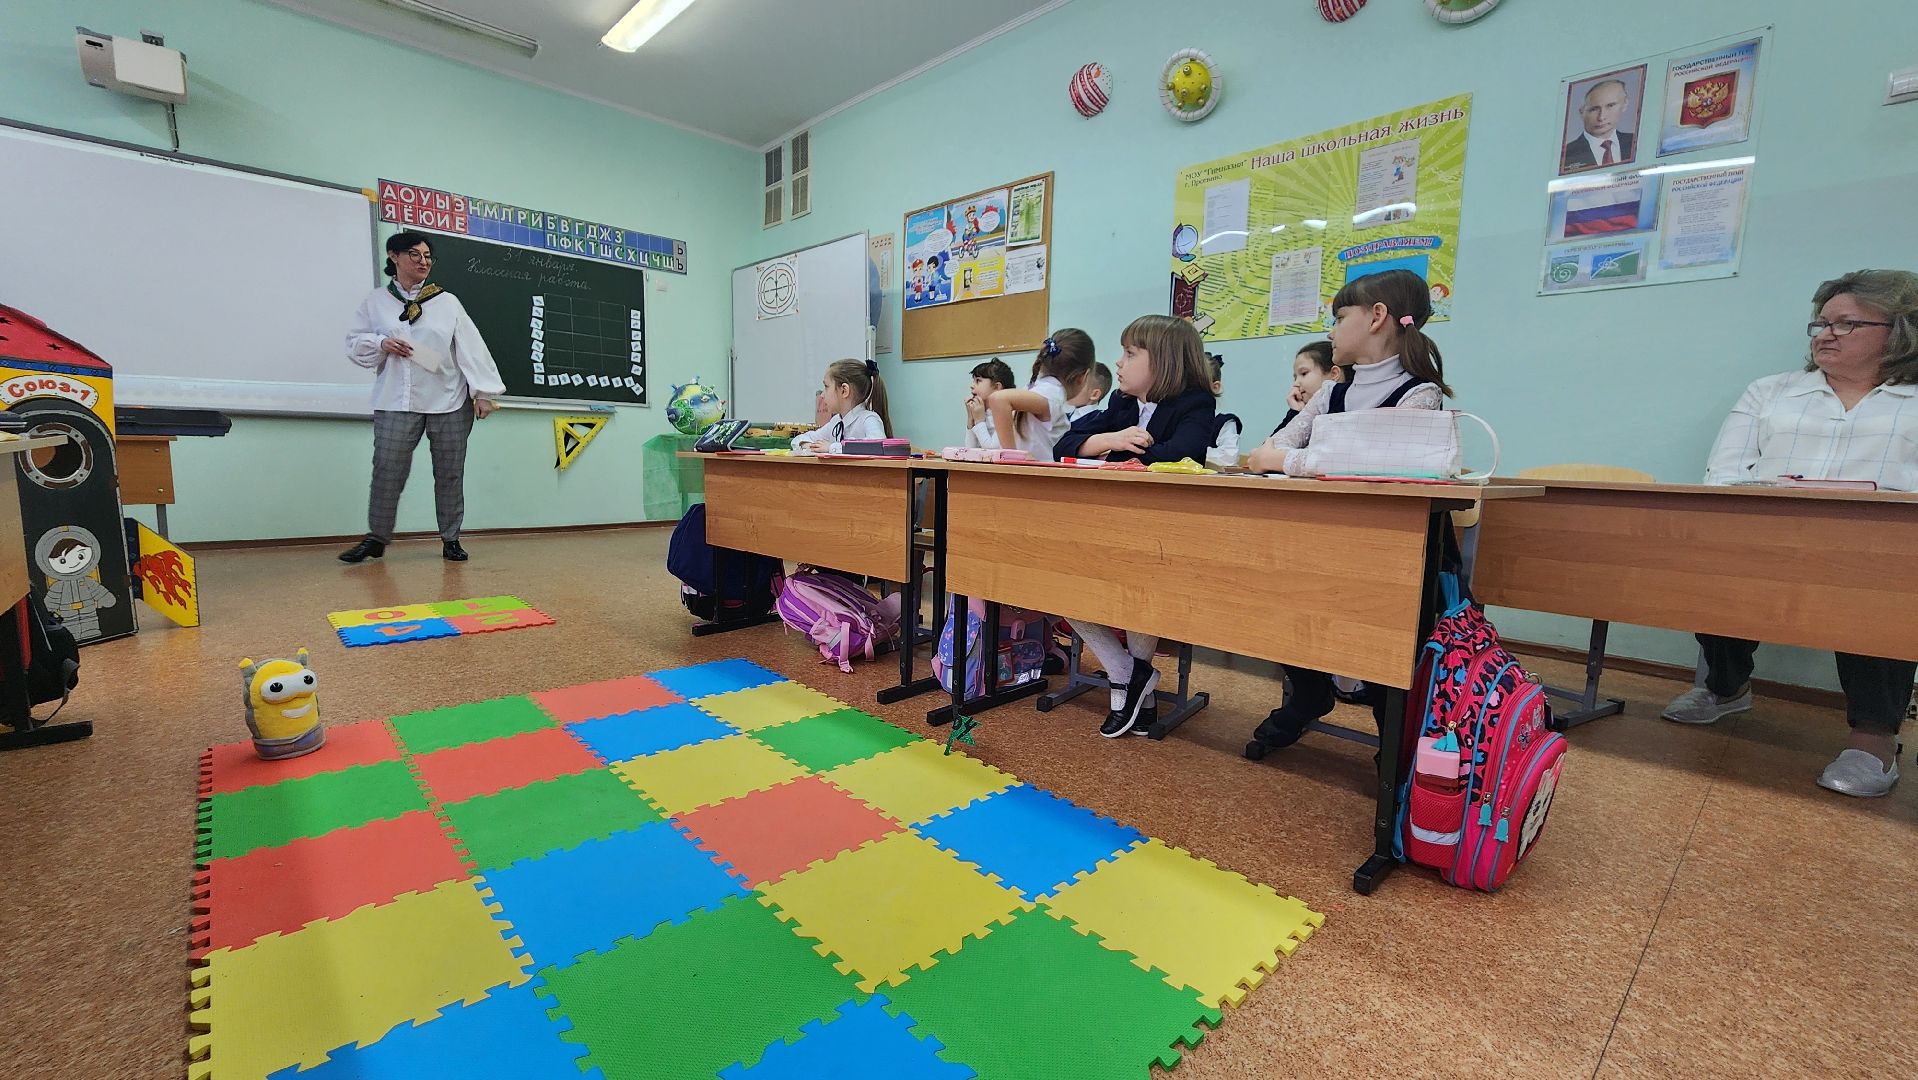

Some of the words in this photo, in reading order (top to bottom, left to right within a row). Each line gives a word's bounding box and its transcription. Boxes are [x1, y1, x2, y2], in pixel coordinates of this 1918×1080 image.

[1250, 150, 1296, 170] Наша
[1300, 125, 1391, 158] школьная
[1398, 107, 1465, 134] жизнь
[503, 247, 523, 262] 31
[467, 257, 532, 281] Классная
